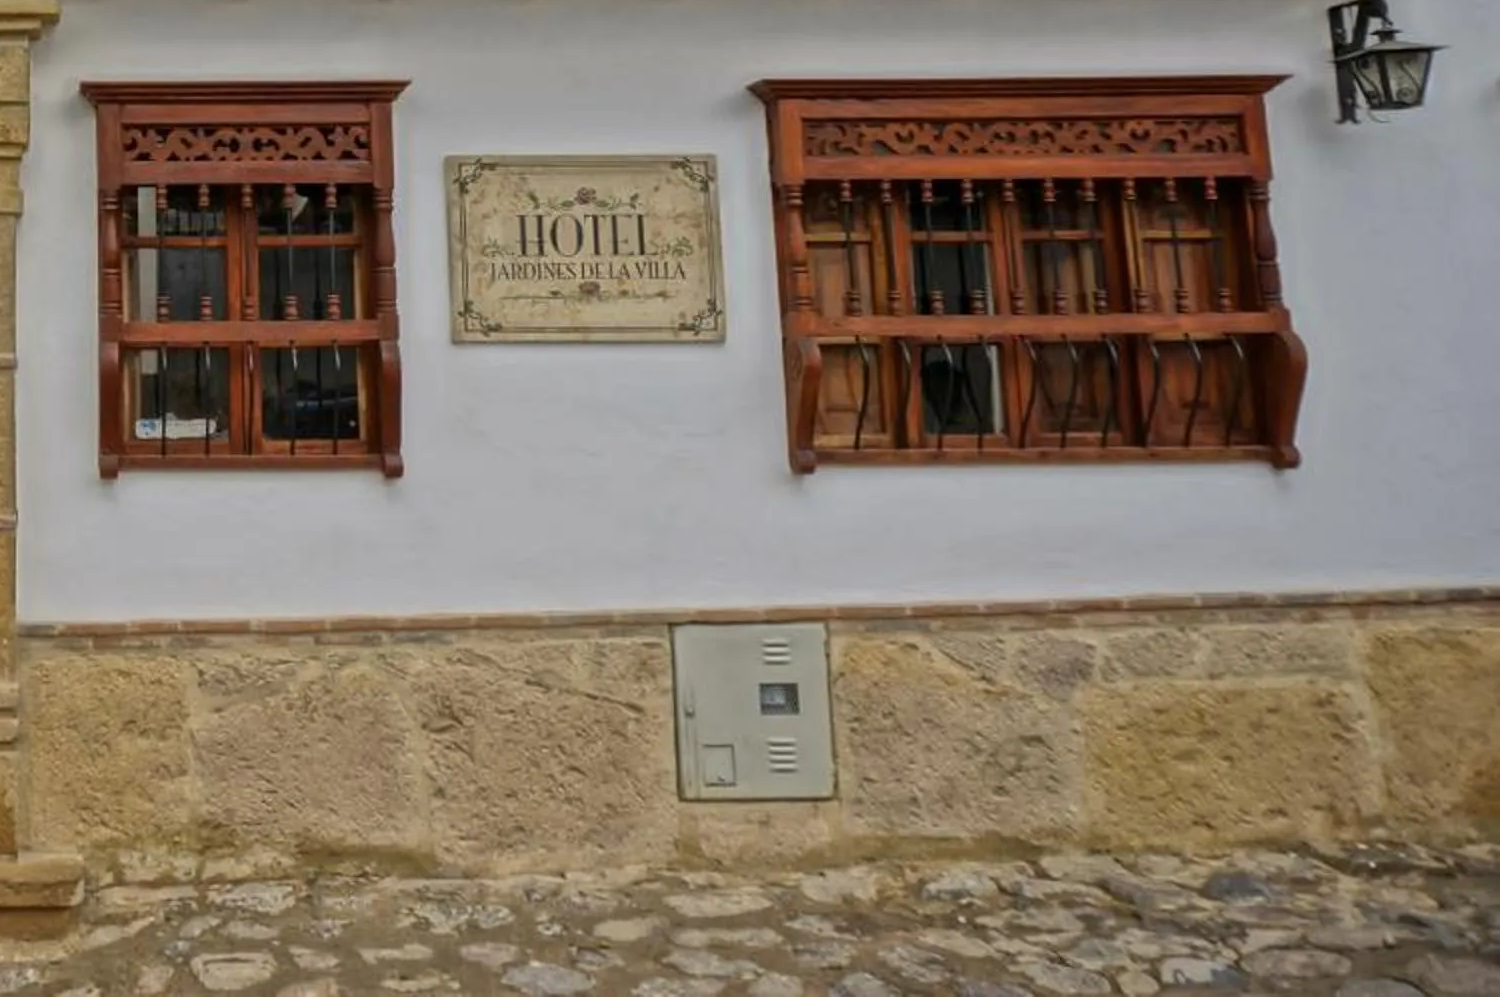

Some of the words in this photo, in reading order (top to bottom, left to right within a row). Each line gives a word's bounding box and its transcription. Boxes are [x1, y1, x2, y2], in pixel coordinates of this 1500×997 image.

[515, 213, 660, 257] HOTEL
[488, 262, 577, 282] JARDINES
[580, 262, 605, 280] DE
[608, 261, 631, 280] LA
[634, 261, 686, 280] VILLA
